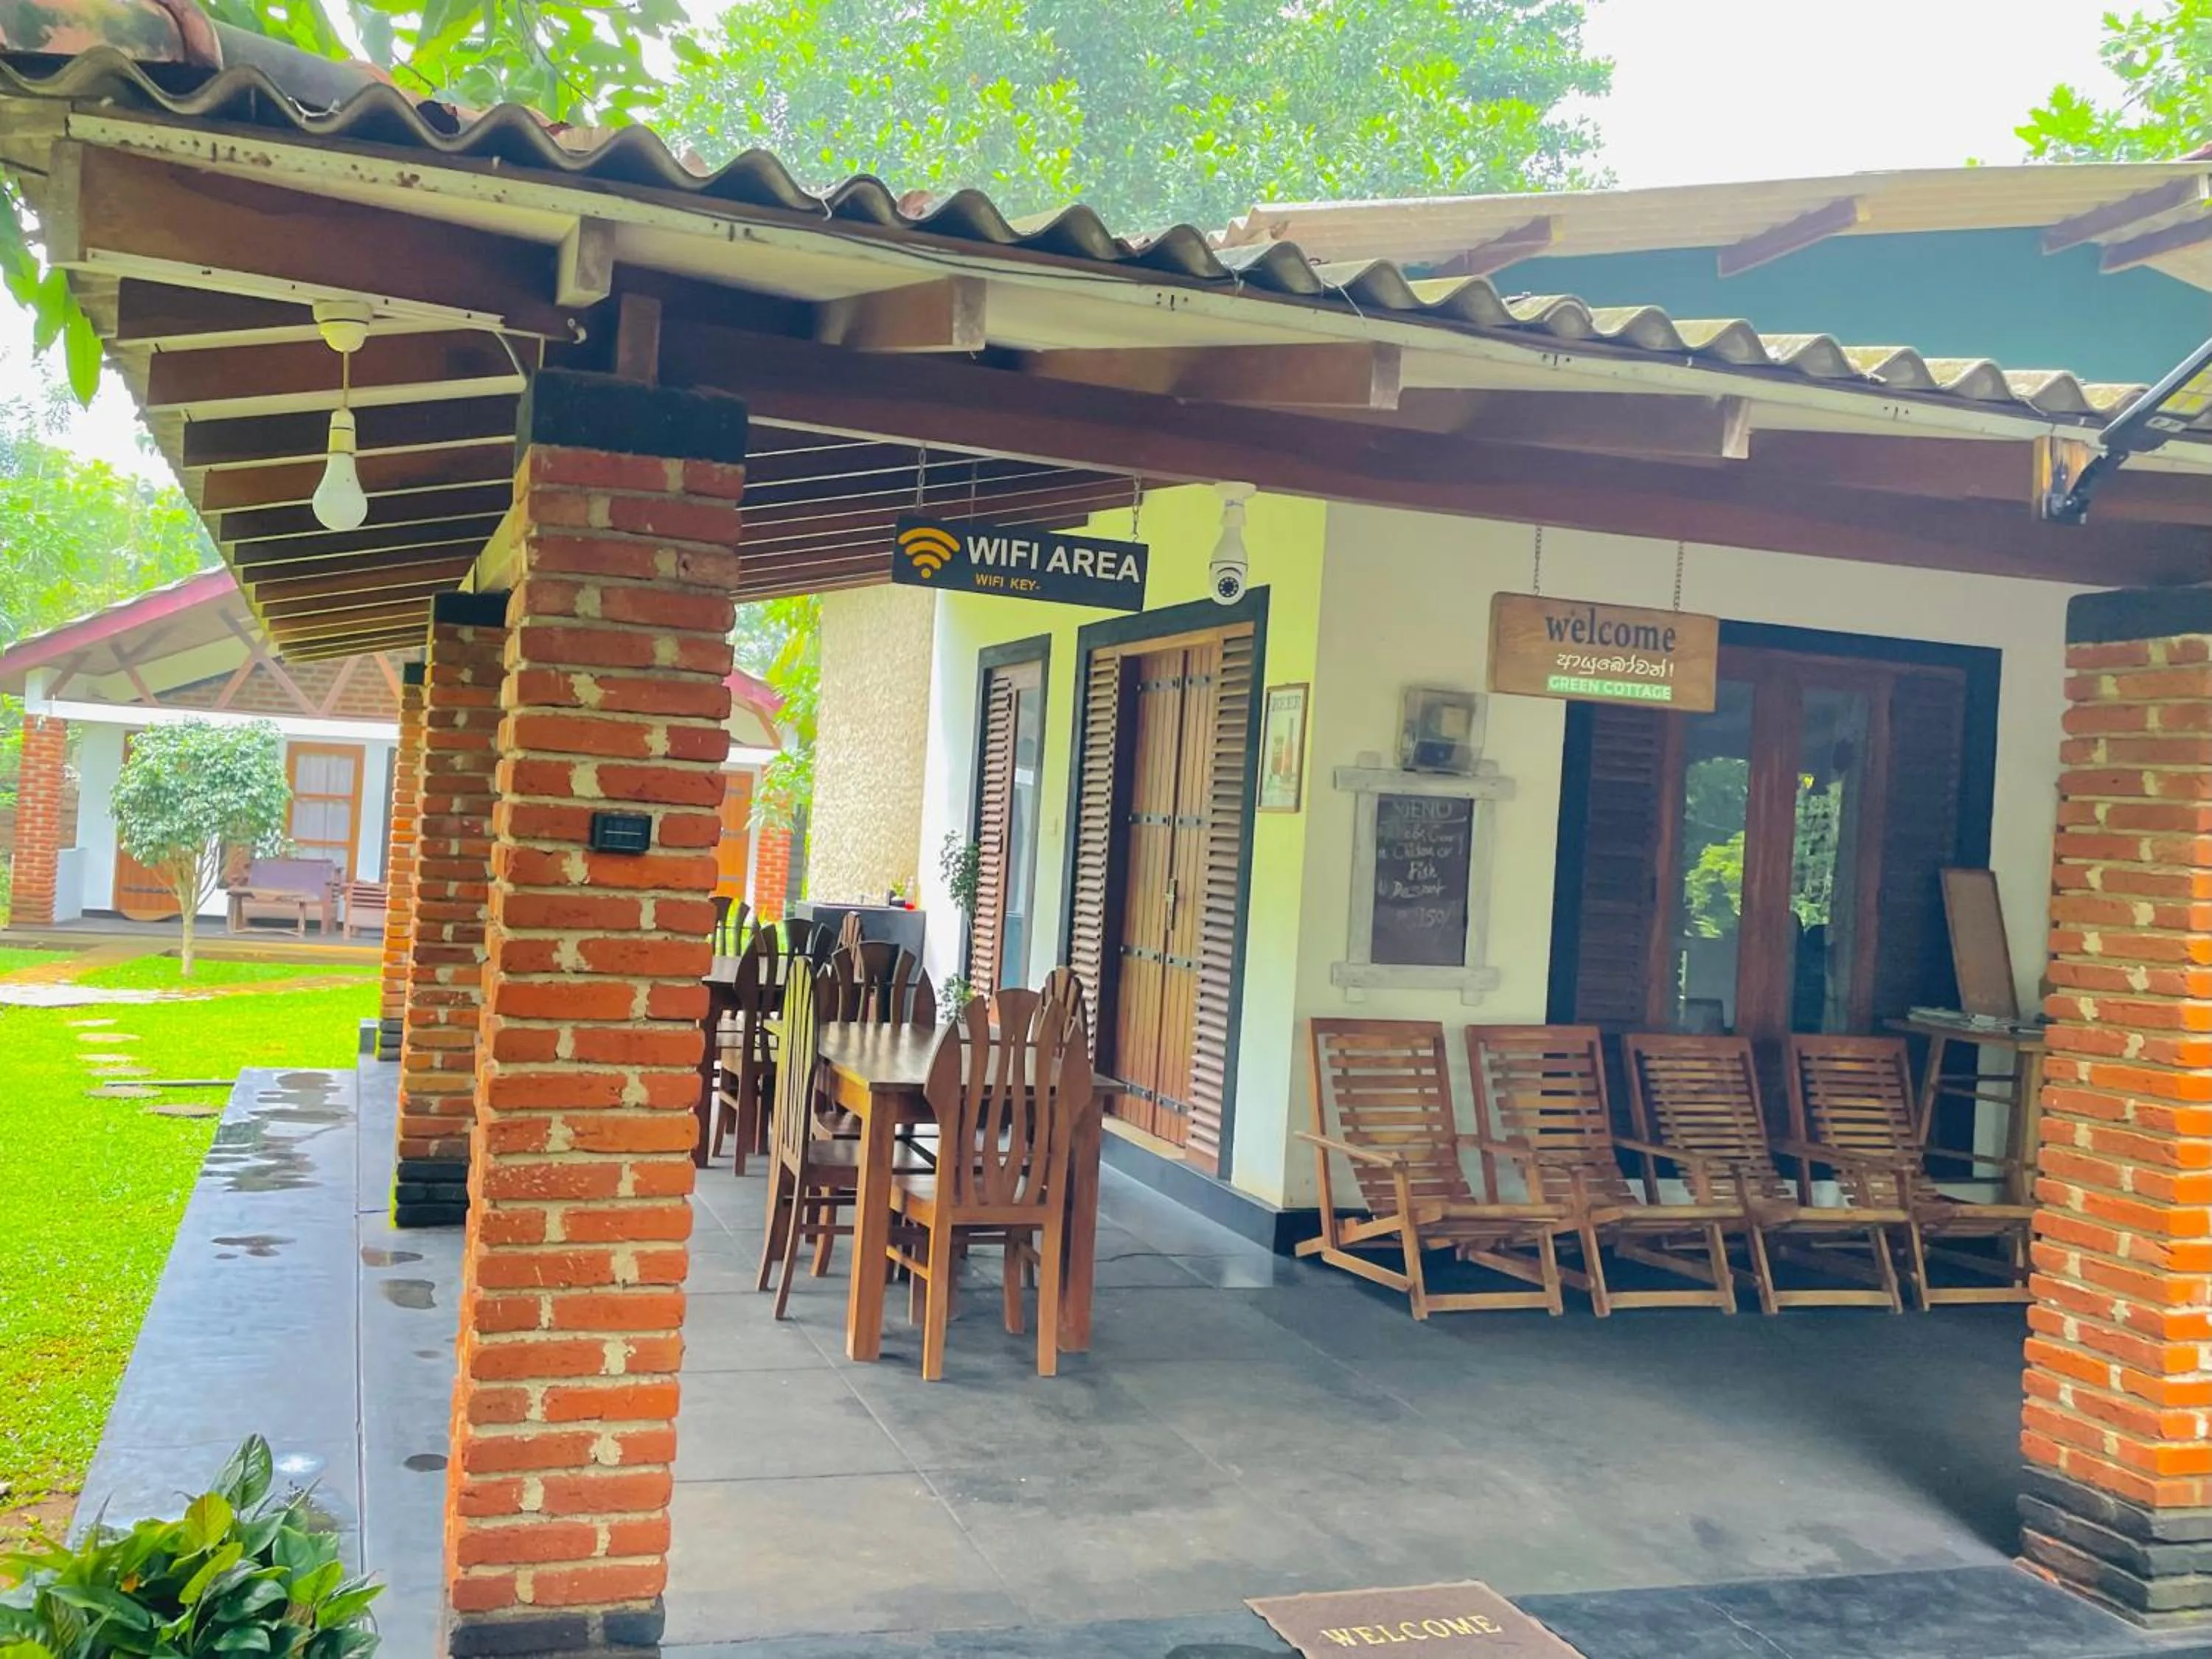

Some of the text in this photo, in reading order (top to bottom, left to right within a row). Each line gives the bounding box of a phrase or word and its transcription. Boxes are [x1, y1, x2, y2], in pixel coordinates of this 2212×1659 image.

[967, 536, 1141, 583] WIFI AREA
[975, 573, 1004, 588] WIFI
[1545, 607, 1677, 651] welcome
[1548, 676, 1672, 700] GREEN COTTAGE
[1321, 1615, 1503, 1647] WELCOME
